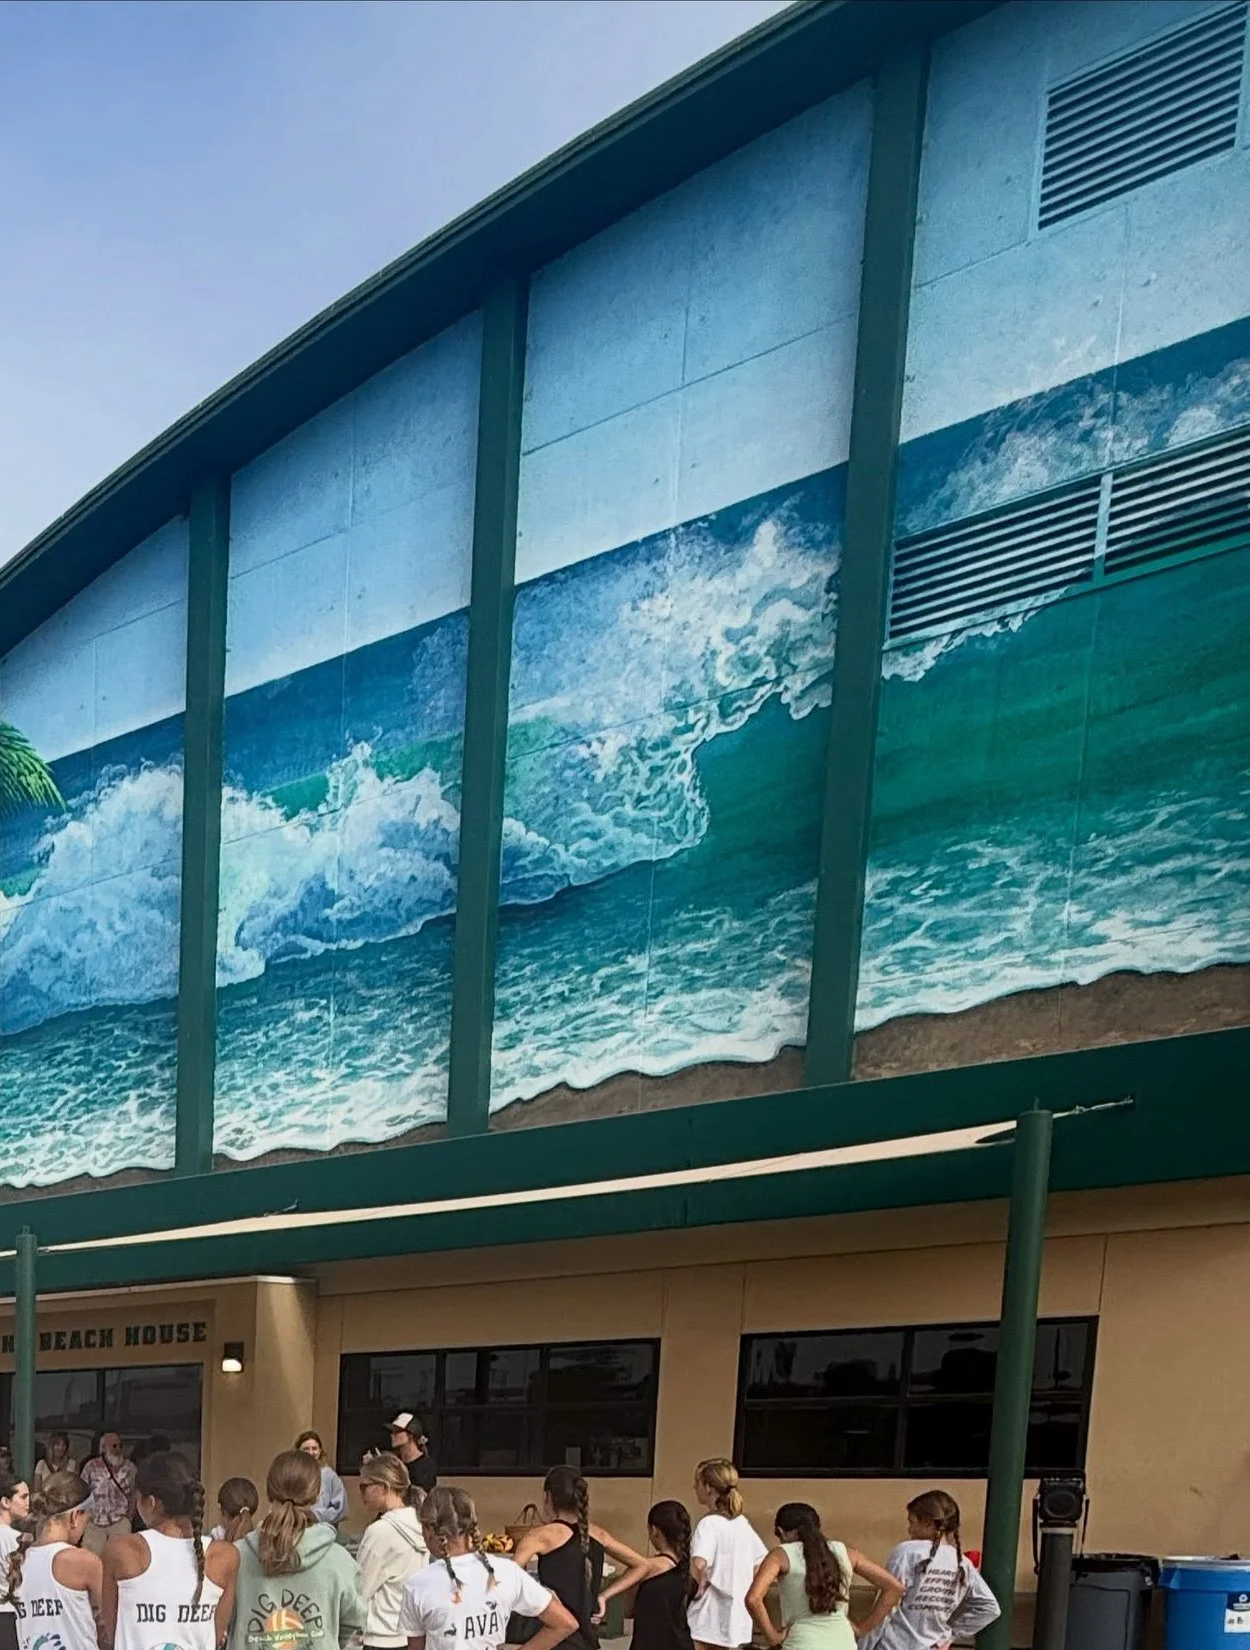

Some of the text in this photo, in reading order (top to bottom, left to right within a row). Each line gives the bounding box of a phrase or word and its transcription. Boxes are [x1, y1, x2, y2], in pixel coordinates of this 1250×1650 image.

[39, 1328, 114, 1351] BEACH
[124, 1321, 207, 1346] HOUSE
[137, 1603, 166, 1623] DIG
[247, 1588, 323, 1633] DIG DEEP
[464, 1611, 499, 1640] AVA
